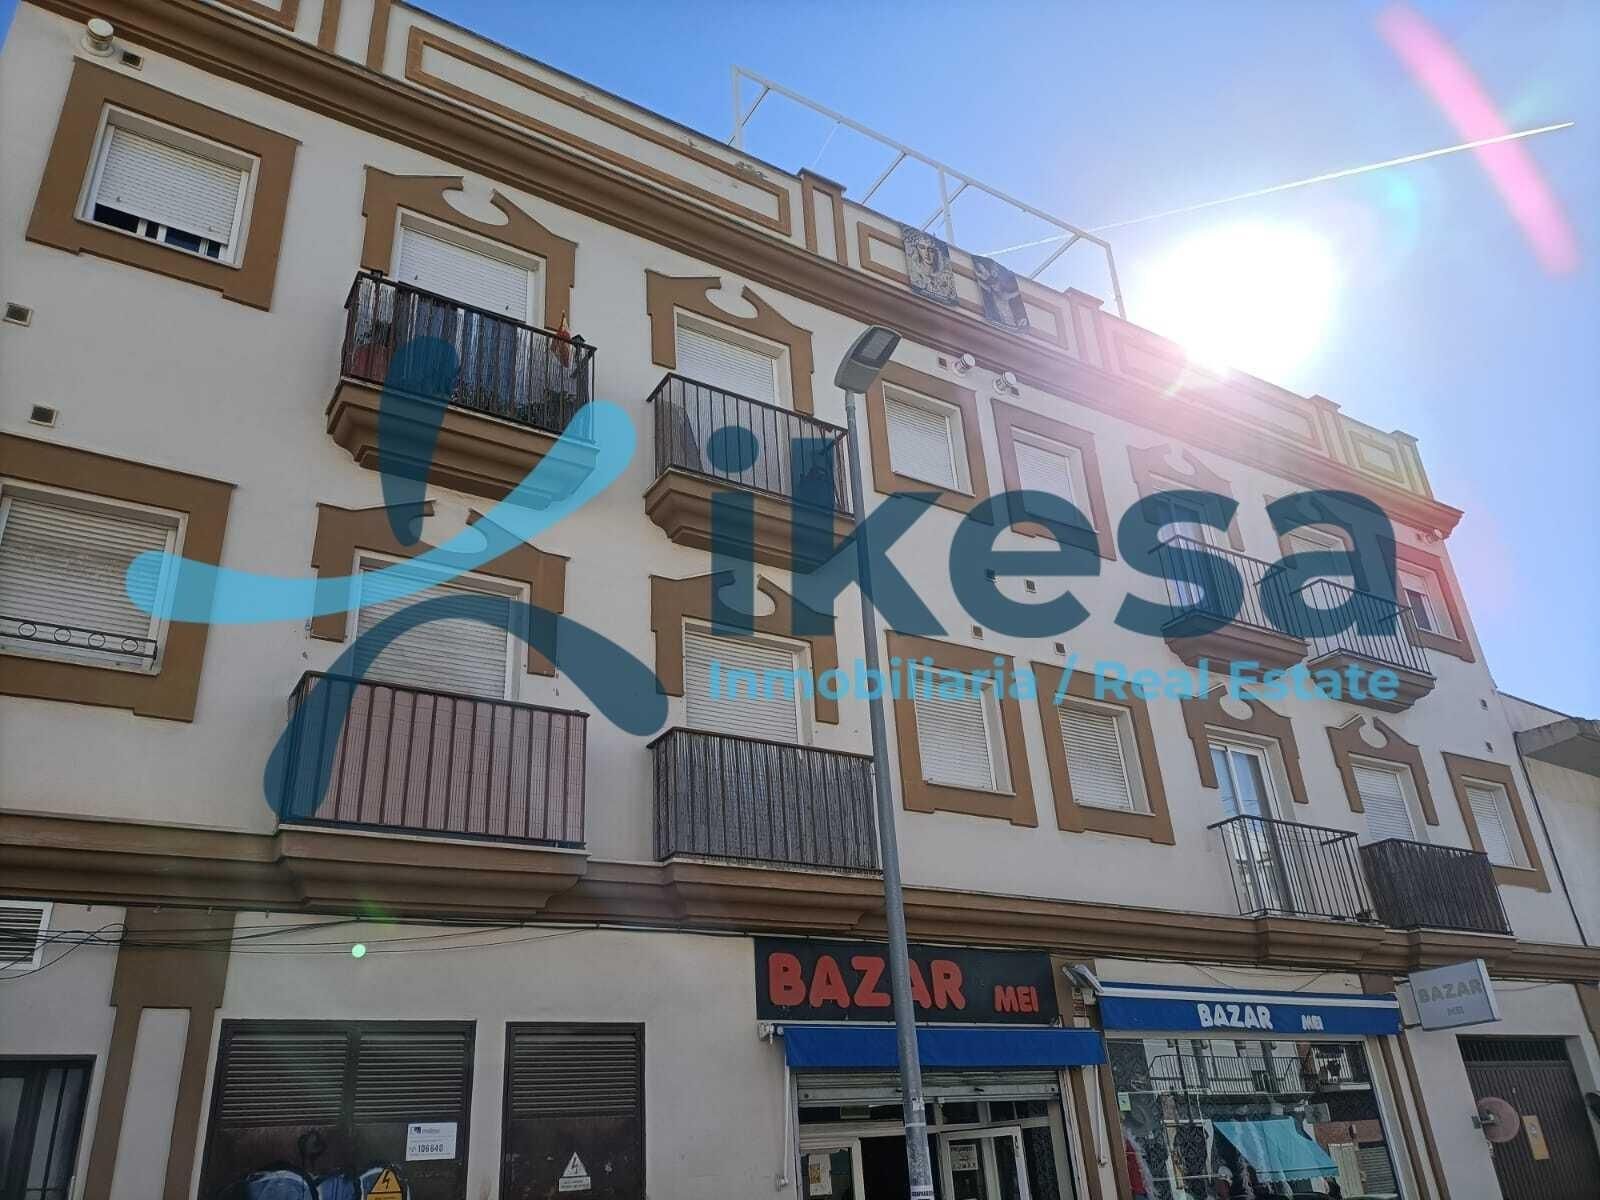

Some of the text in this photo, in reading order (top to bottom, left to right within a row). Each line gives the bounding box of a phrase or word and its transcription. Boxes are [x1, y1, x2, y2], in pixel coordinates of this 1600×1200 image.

[995, 985, 1039, 1012] MEI
[1417, 979, 1483, 1003] BAZAR
[1197, 1003, 1324, 1030] BAZAR MEI
